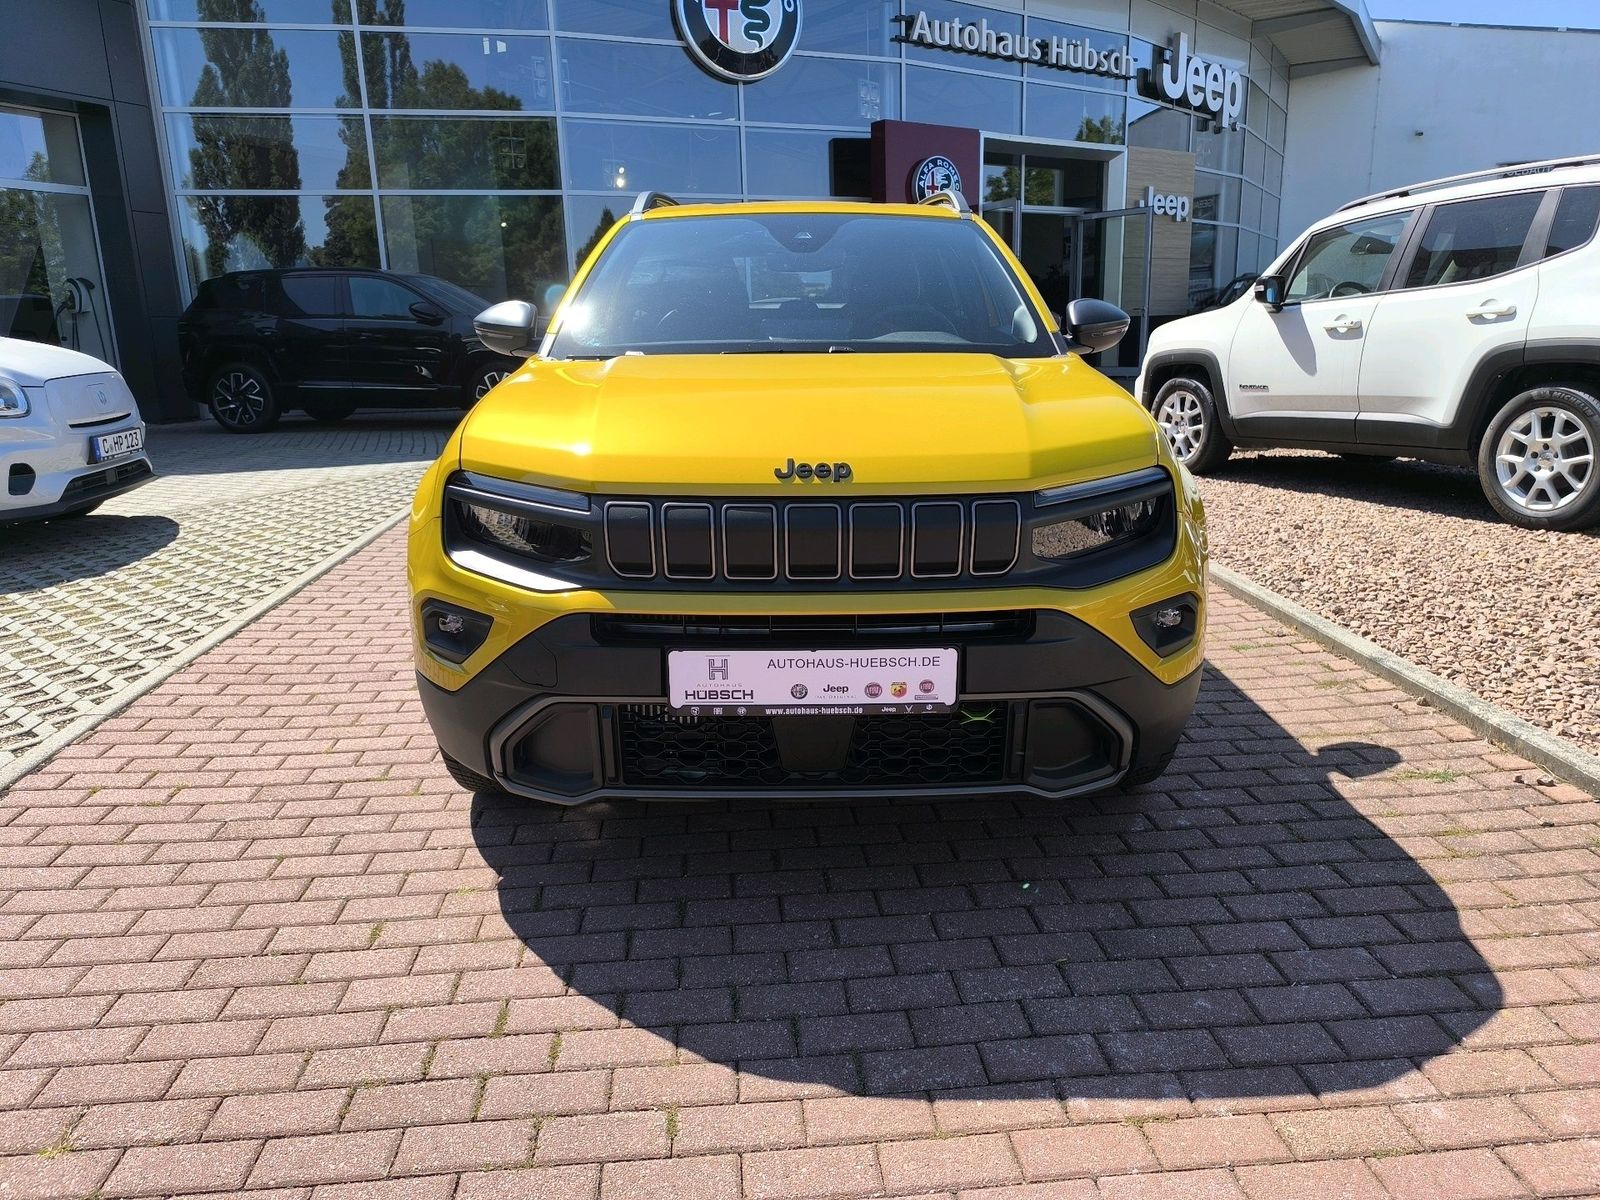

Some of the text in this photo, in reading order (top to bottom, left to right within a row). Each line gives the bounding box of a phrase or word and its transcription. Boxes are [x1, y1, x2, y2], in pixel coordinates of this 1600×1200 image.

[910, 11, 1134, 76] Autohaus Hübsch
[1162, 32, 1242, 128] Jeep
[919, 160, 960, 190] ALFA ROMEO
[102, 431, 139, 454] C HP 123
[774, 458, 852, 482] Jeep
[767, 656, 941, 669] AUTOHAUS-HUEBSCH.DE
[685, 689, 754, 700] HÜBSCH
[823, 684, 849, 694] Jeep
[765, 706, 863, 715] www.autohaus-huebsch.de
